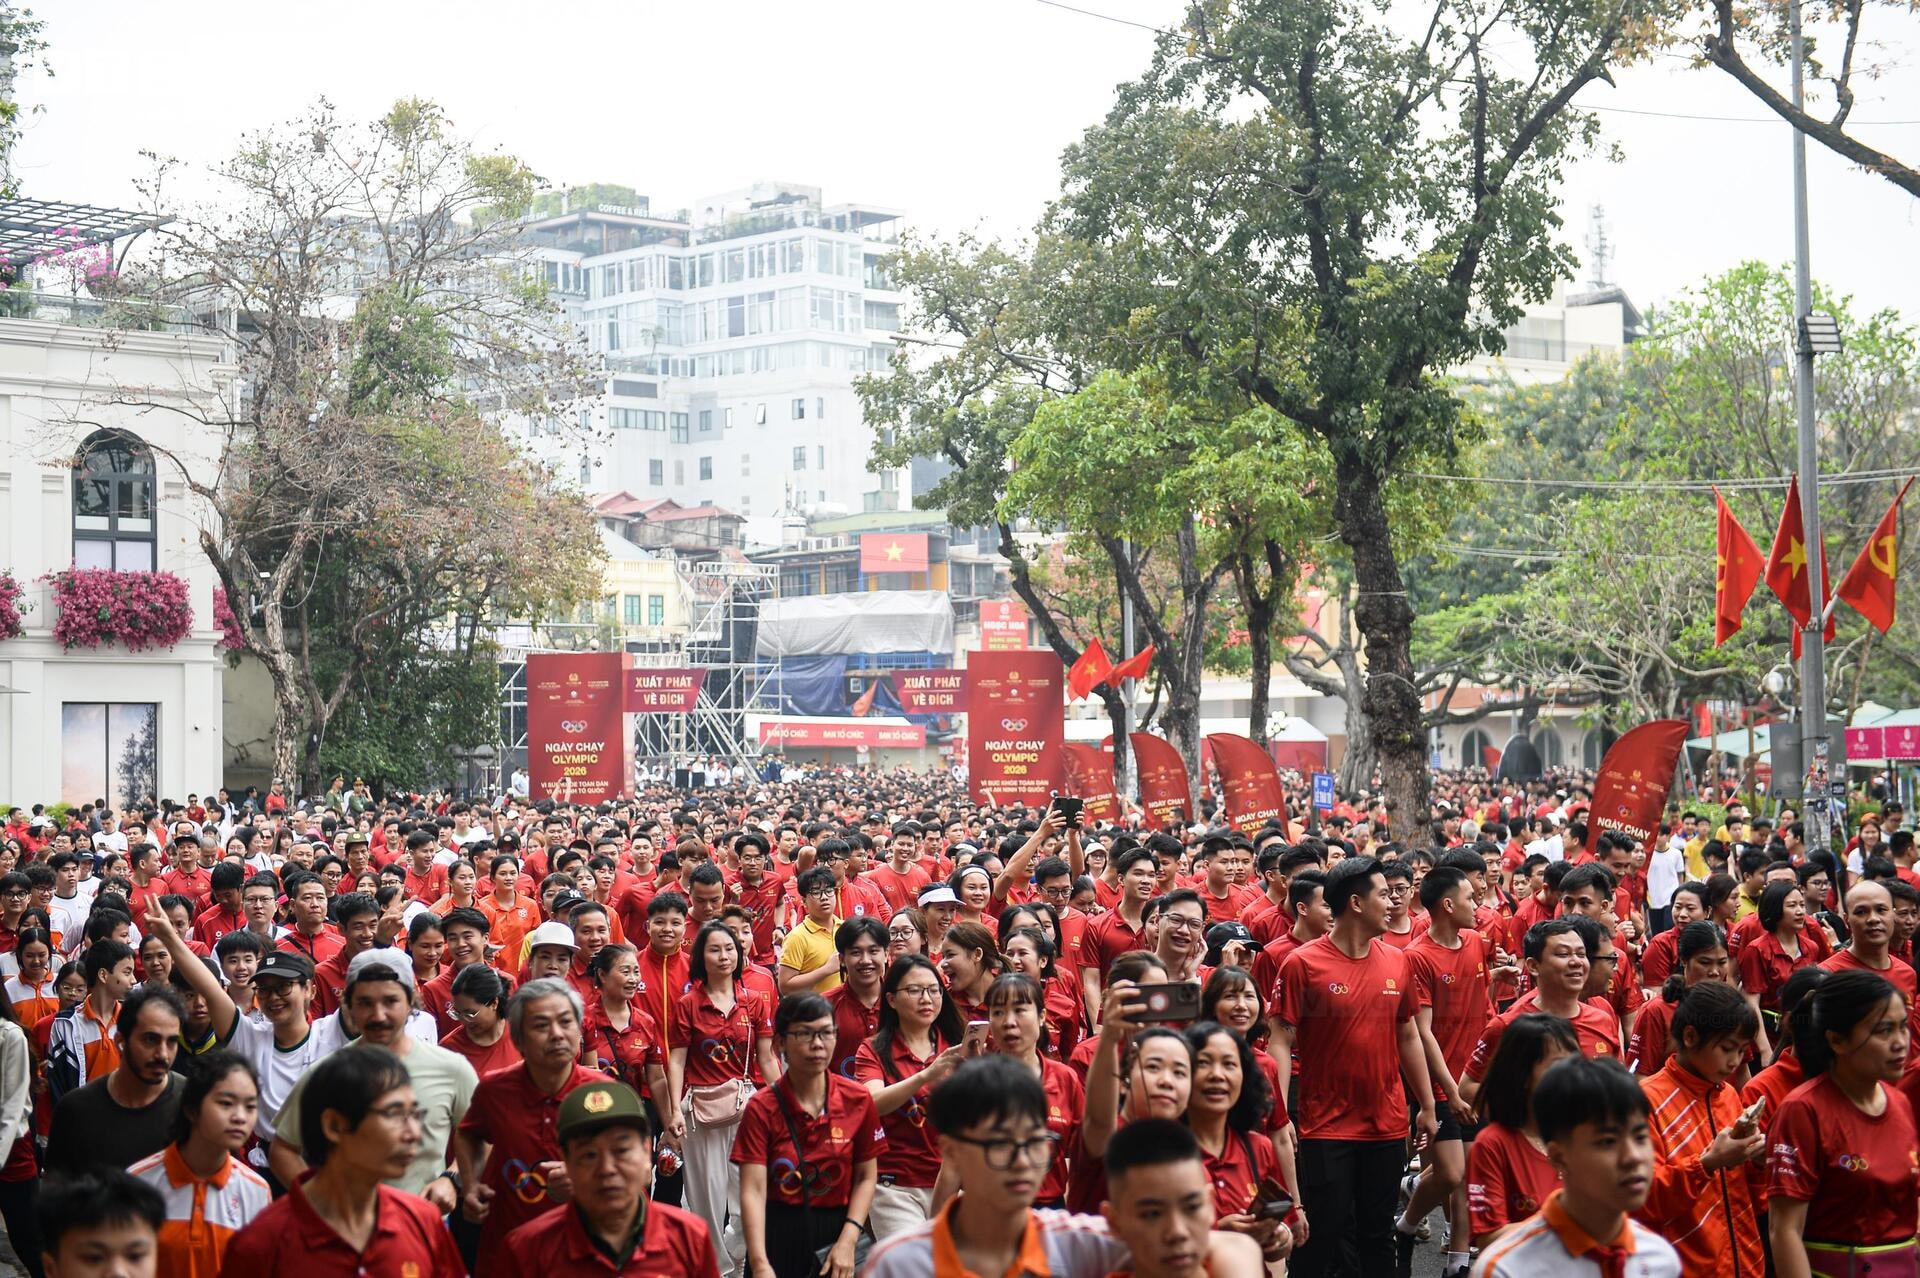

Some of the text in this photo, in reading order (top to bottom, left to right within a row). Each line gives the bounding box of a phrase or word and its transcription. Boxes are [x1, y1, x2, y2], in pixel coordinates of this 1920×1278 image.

[598, 204, 626, 214] COFFEE
[636, 675, 692, 688] XUẤT PHÁT
[904, 676, 931, 688] XUẤT
[934, 675, 962, 688] PHÁT
[643, 692, 684, 705] VỀ ĐÍCH
[912, 693, 953, 705] VỀ ĐÍCH
[545, 742, 605, 752] NGÀY CHẠY
[985, 740, 1045, 752] NGÀY CHẠY
[552, 755, 598, 764] OLYMPIC
[992, 752, 1038, 763] OLYMPIC
[564, 767, 587, 776] 2026
[1003, 765, 1027, 774] 2026
